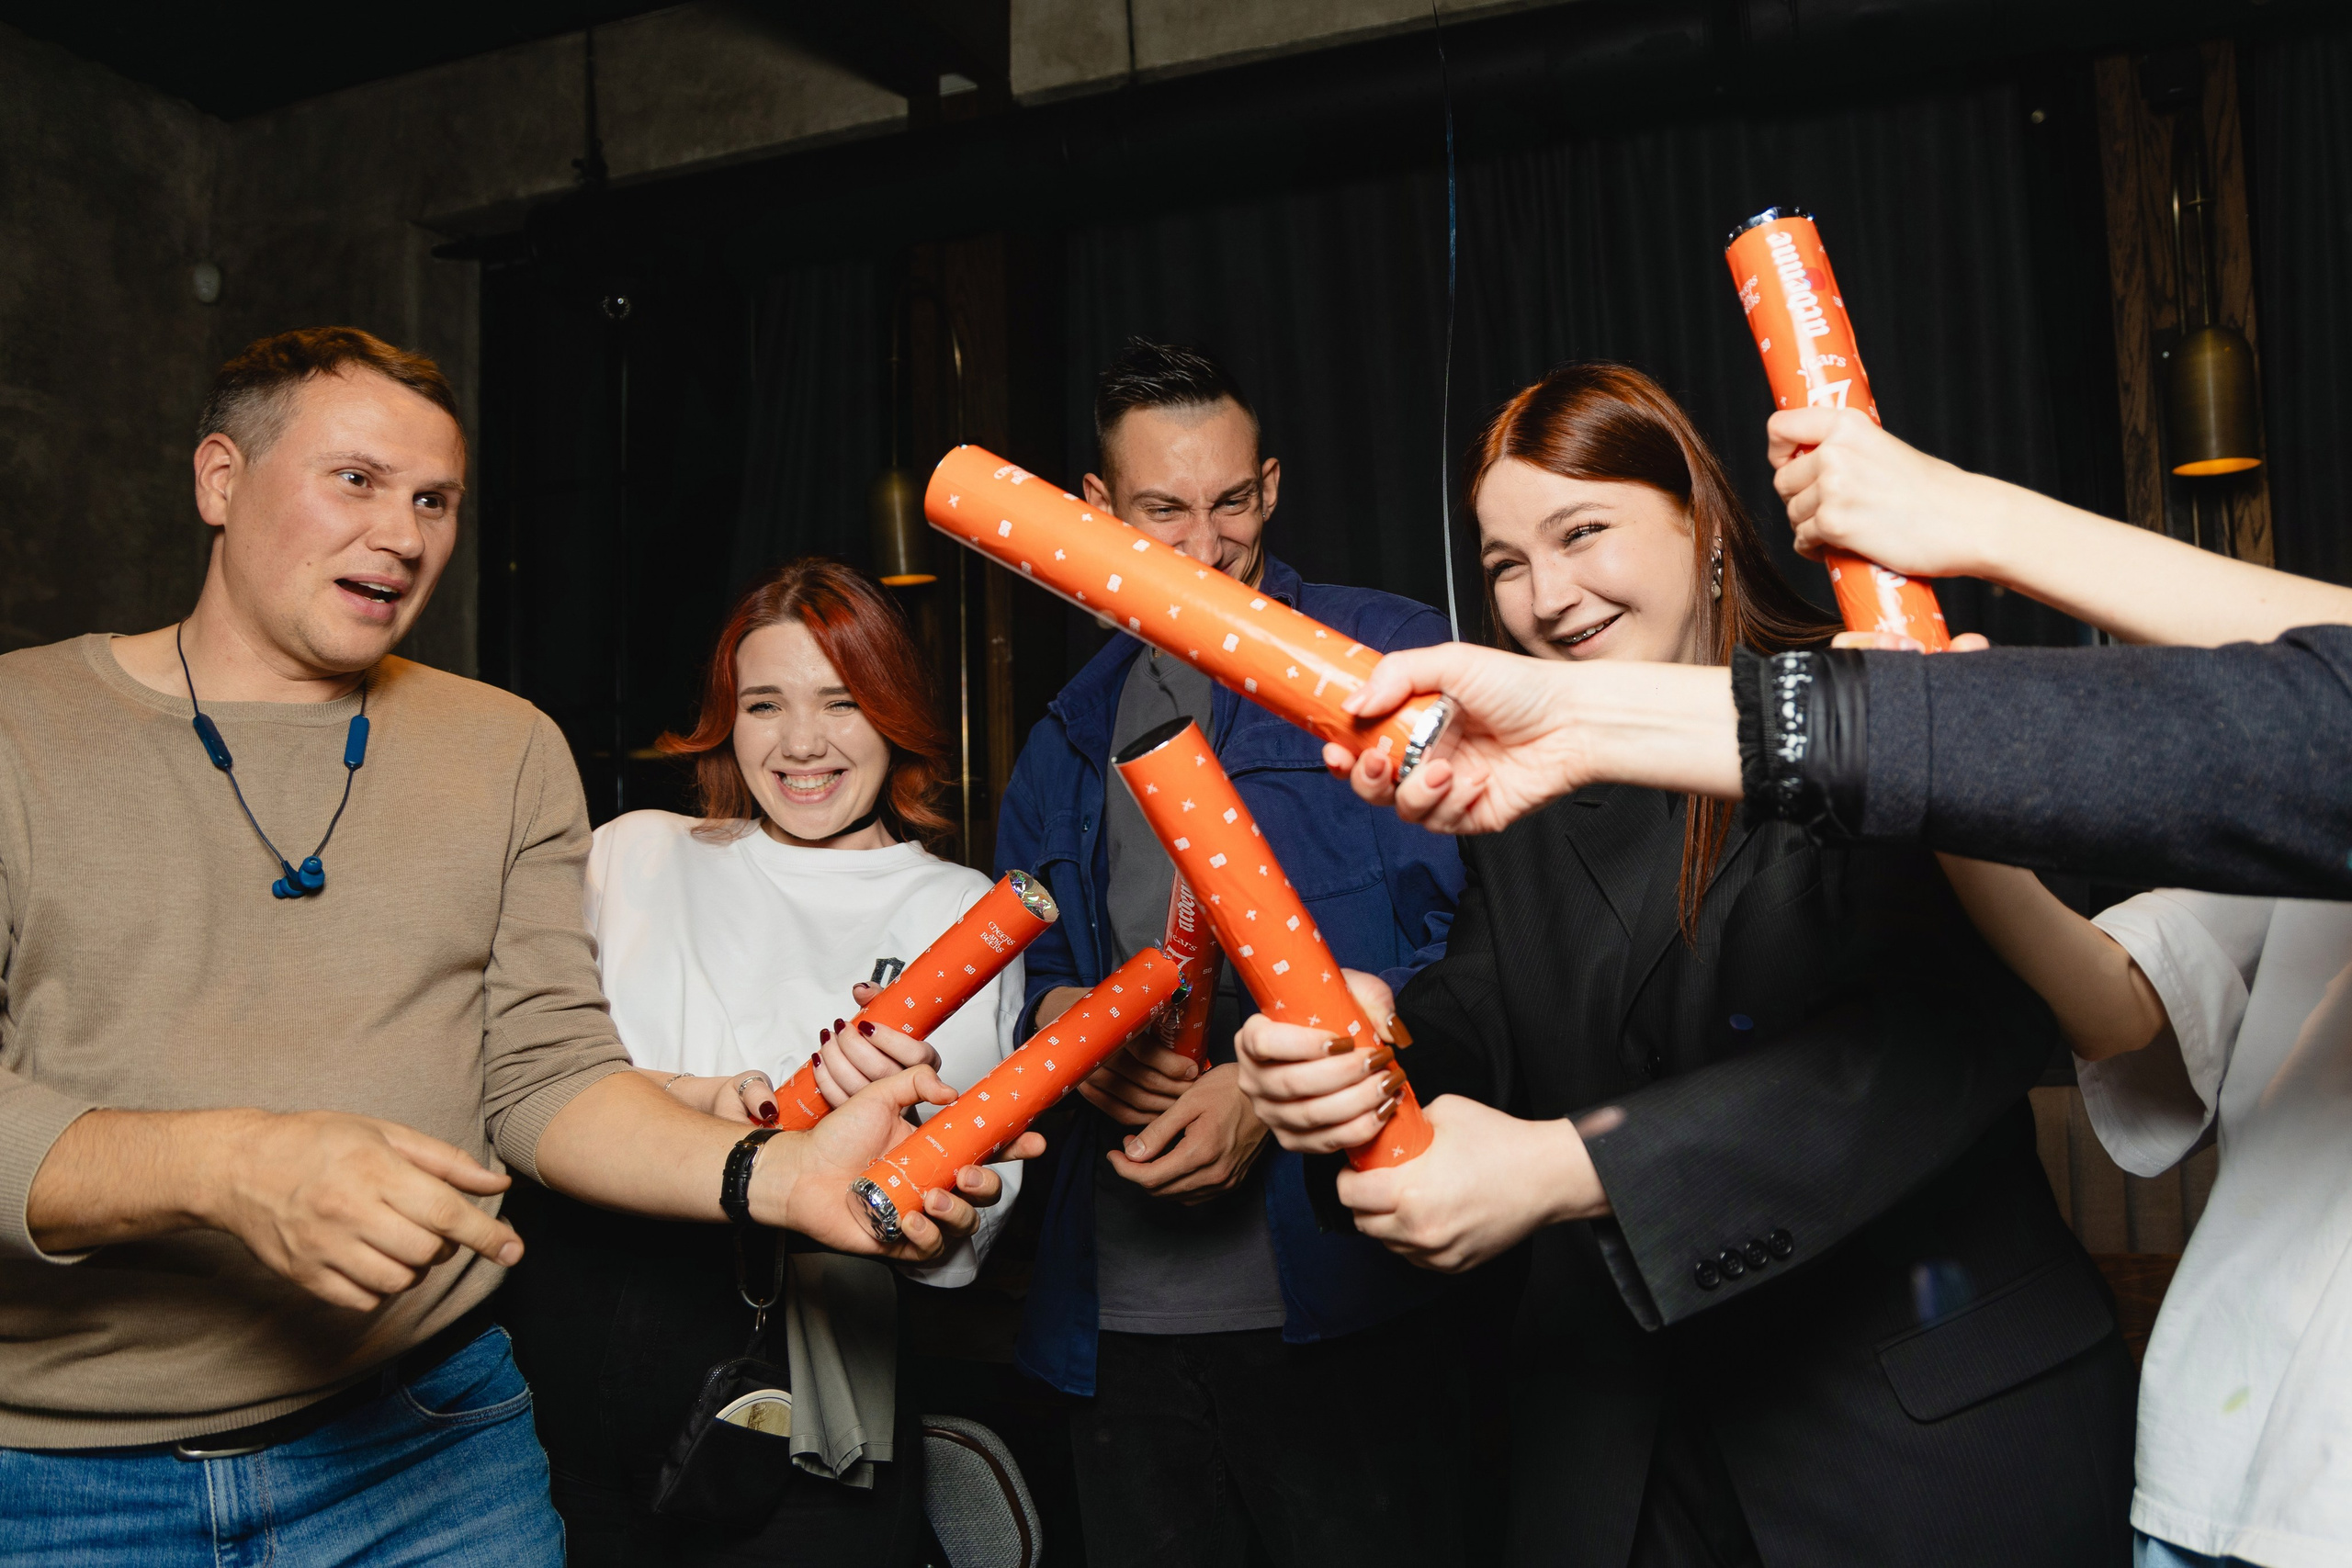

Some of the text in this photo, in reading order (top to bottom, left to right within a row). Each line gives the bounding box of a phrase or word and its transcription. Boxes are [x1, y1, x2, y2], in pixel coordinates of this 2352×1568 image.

[1178, 879, 1196, 933] arden
[979, 931, 1005, 953] BEERS
[988, 920, 1016, 946] CHEERS
[989, 933, 1004, 947] and
